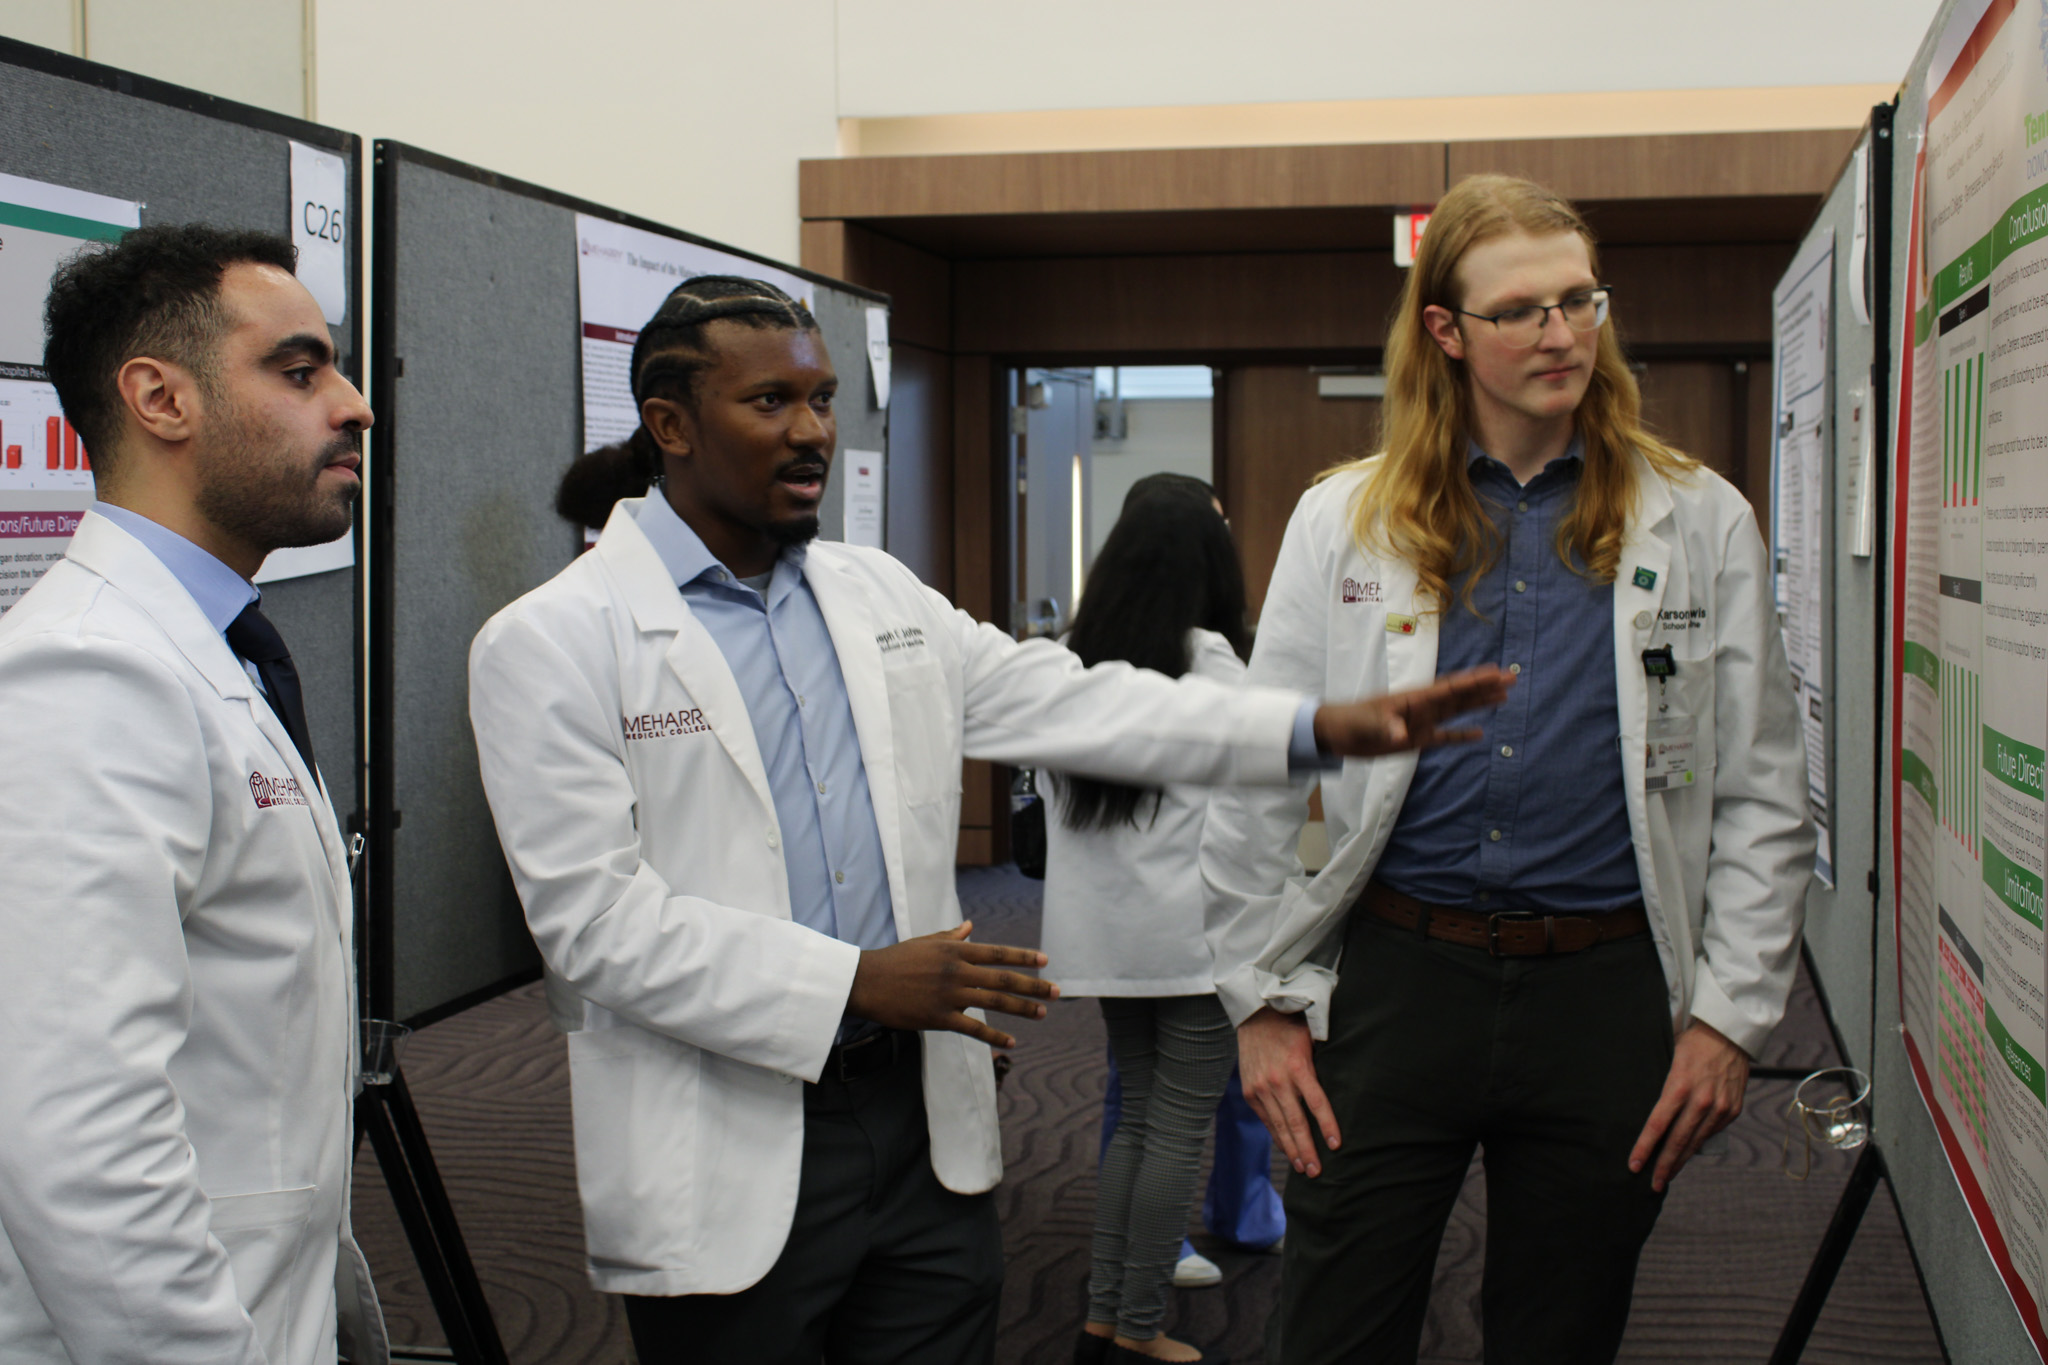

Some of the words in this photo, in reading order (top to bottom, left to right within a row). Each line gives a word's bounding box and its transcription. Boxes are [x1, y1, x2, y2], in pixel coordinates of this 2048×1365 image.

[304, 201, 341, 243] C26
[2019, 296, 2032, 314] would
[2033, 295, 2040, 310] be
[2020, 327, 2044, 352] appeared
[20, 569, 31, 578] the
[1663, 622, 1686, 630] School
[2025, 606, 2042, 627] biggest
[625, 730, 665, 740] MEDICAL
[1997, 743, 2016, 779] Future
[2004, 867, 2043, 921] Limitations
